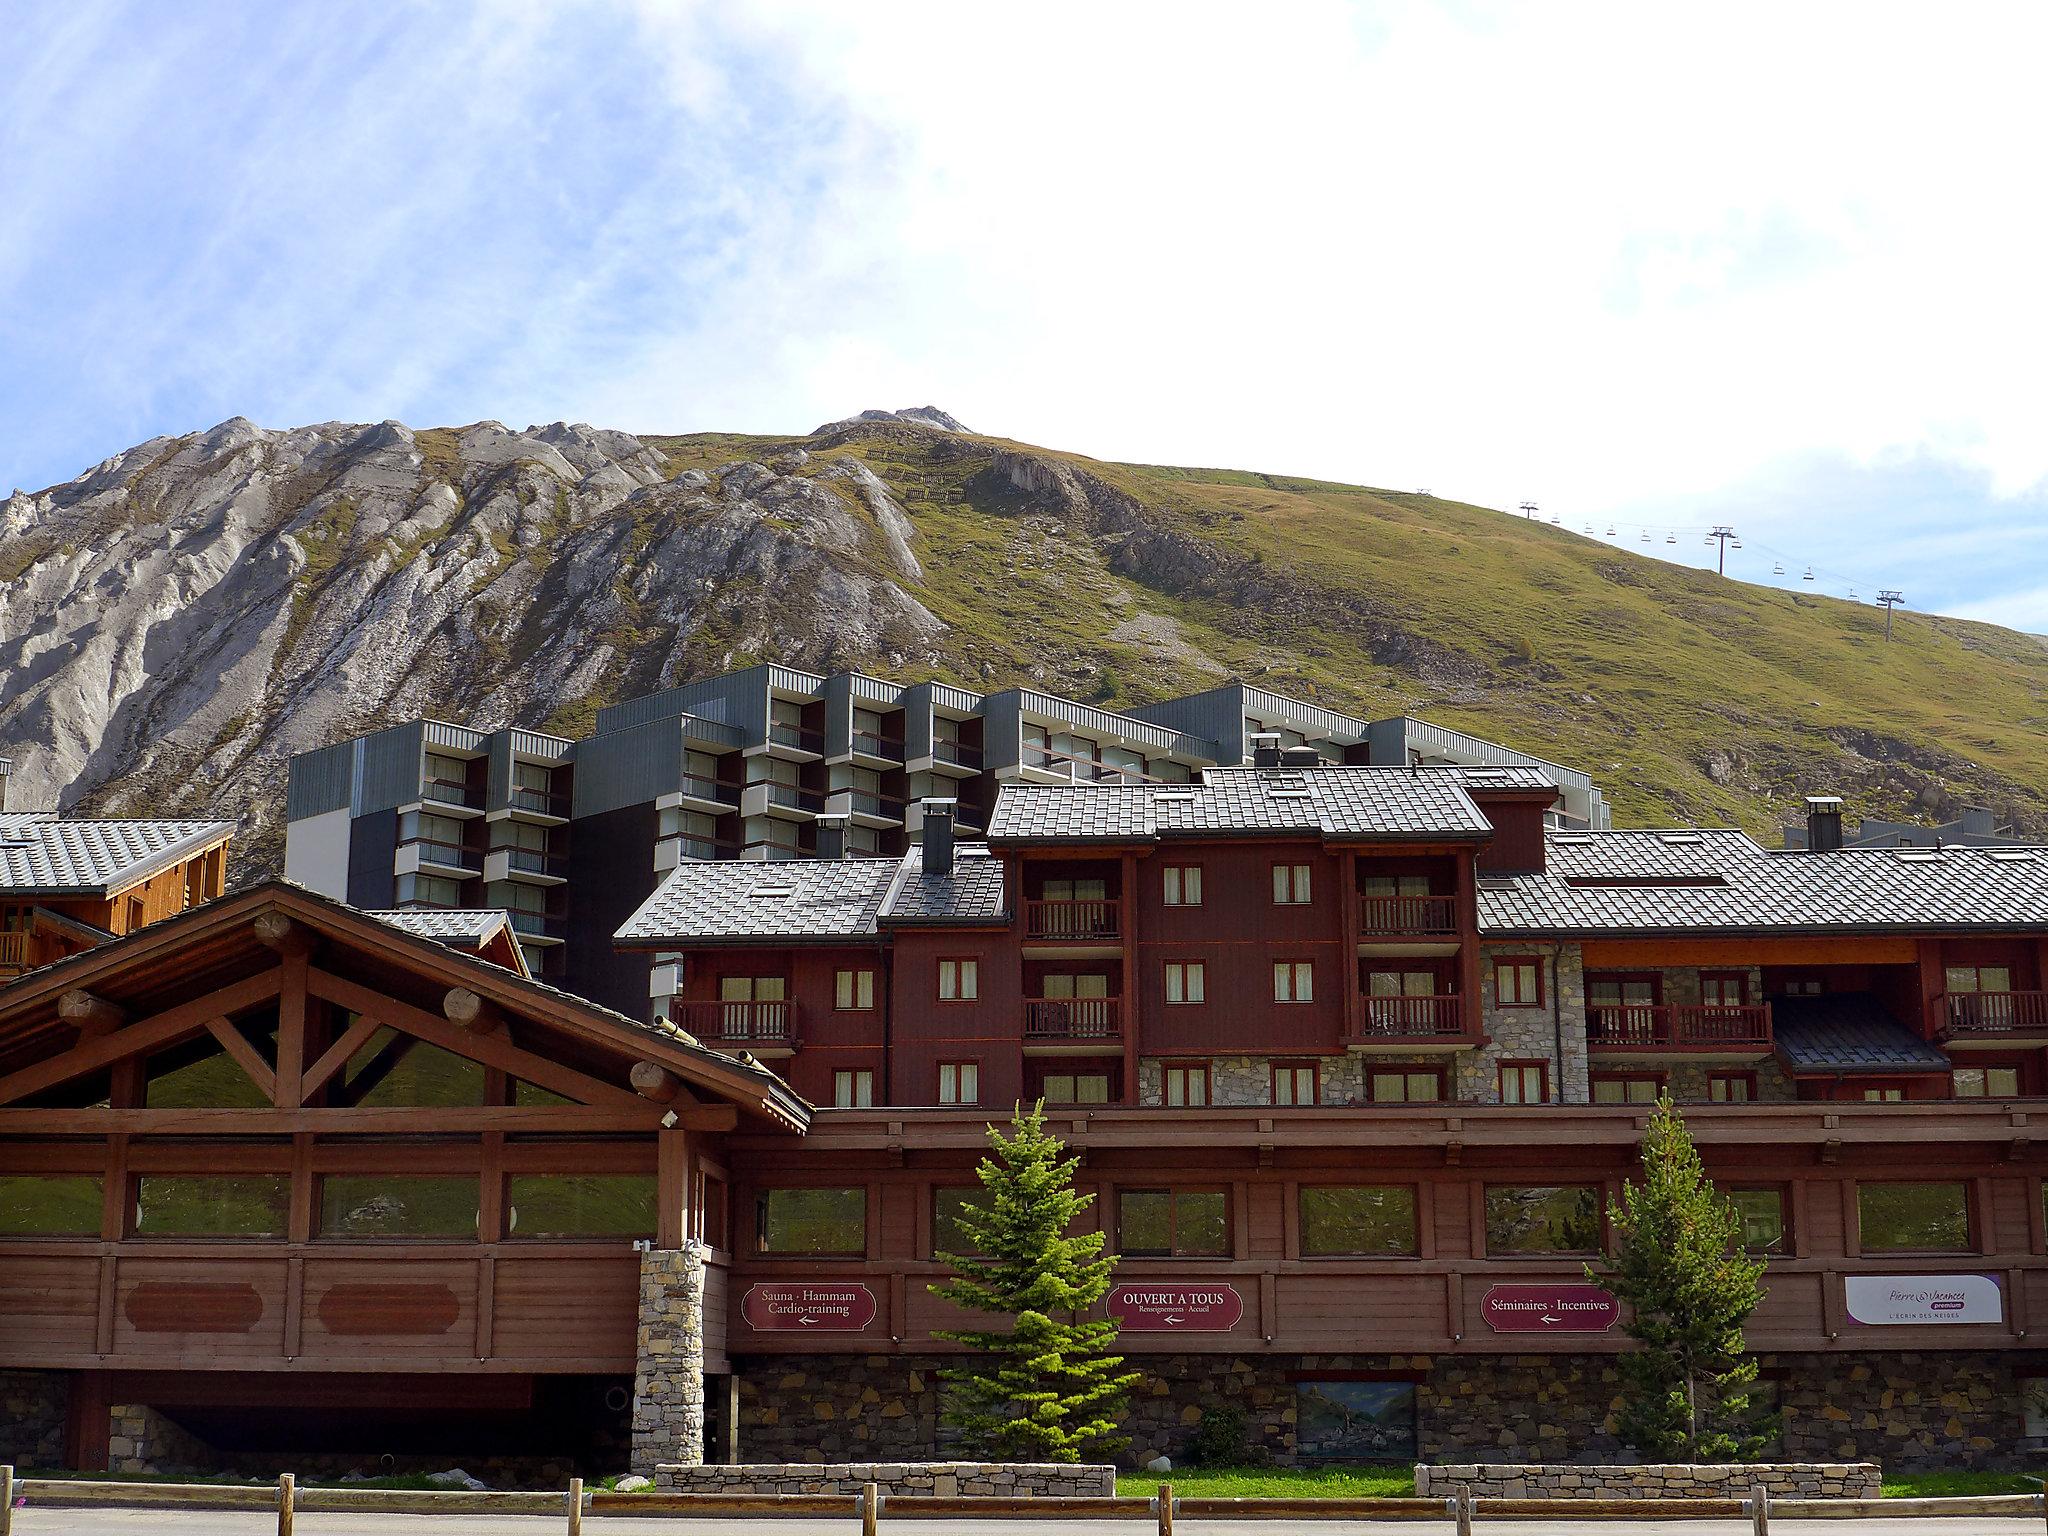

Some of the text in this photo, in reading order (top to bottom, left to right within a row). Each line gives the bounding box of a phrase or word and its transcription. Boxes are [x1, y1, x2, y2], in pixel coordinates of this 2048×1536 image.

[762, 1290, 856, 1301] Sauna Hammam
[1123, 1293, 1224, 1304] OUVERT A TOUS
[1890, 1290, 1915, 1301] Pierre
[1929, 1290, 1965, 1301] Vacances
[768, 1303, 850, 1317] Cardio-training
[1188, 1305, 1210, 1313] Accueil
[1491, 1299, 1609, 1310] Séminaires Incentives
